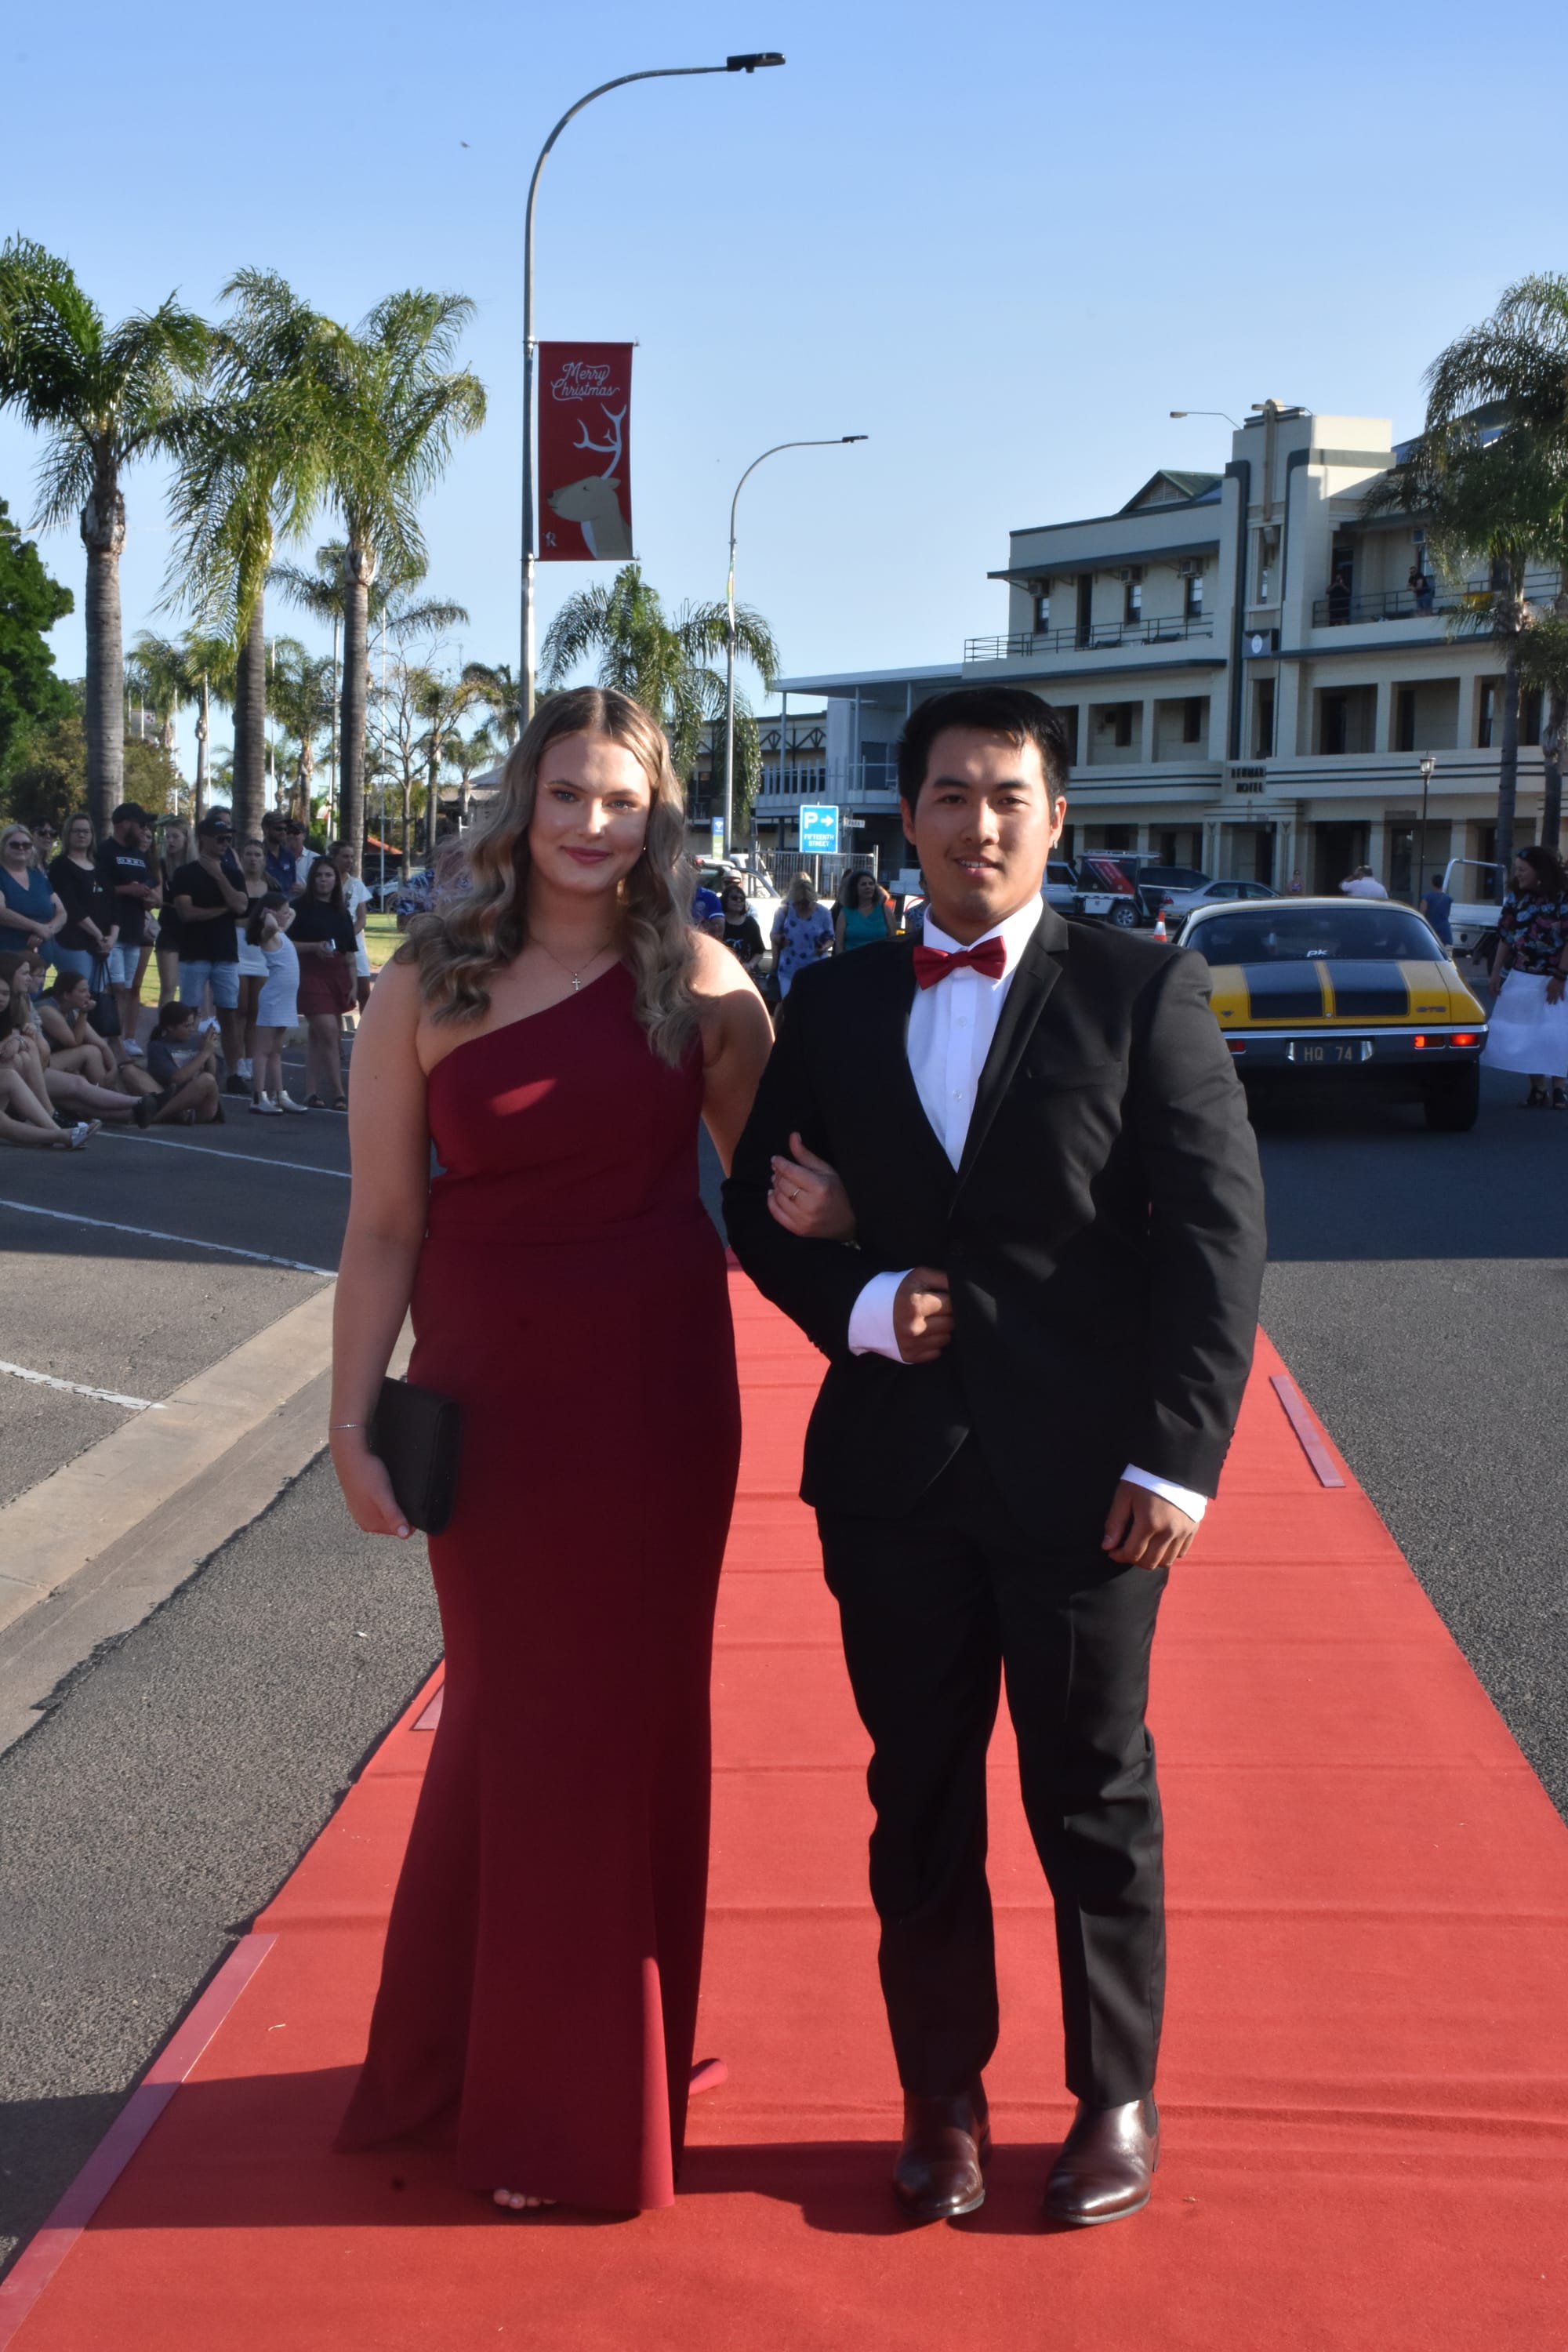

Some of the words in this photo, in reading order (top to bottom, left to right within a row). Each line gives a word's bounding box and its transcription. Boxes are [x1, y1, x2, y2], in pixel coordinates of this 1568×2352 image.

[562, 361, 610, 387] Merry
[550, 379, 620, 401] Christmas
[1236, 782, 1264, 793] HOTEL
[1304, 1047, 1323, 1062] HQ
[1335, 1046, 1352, 1061] 74
